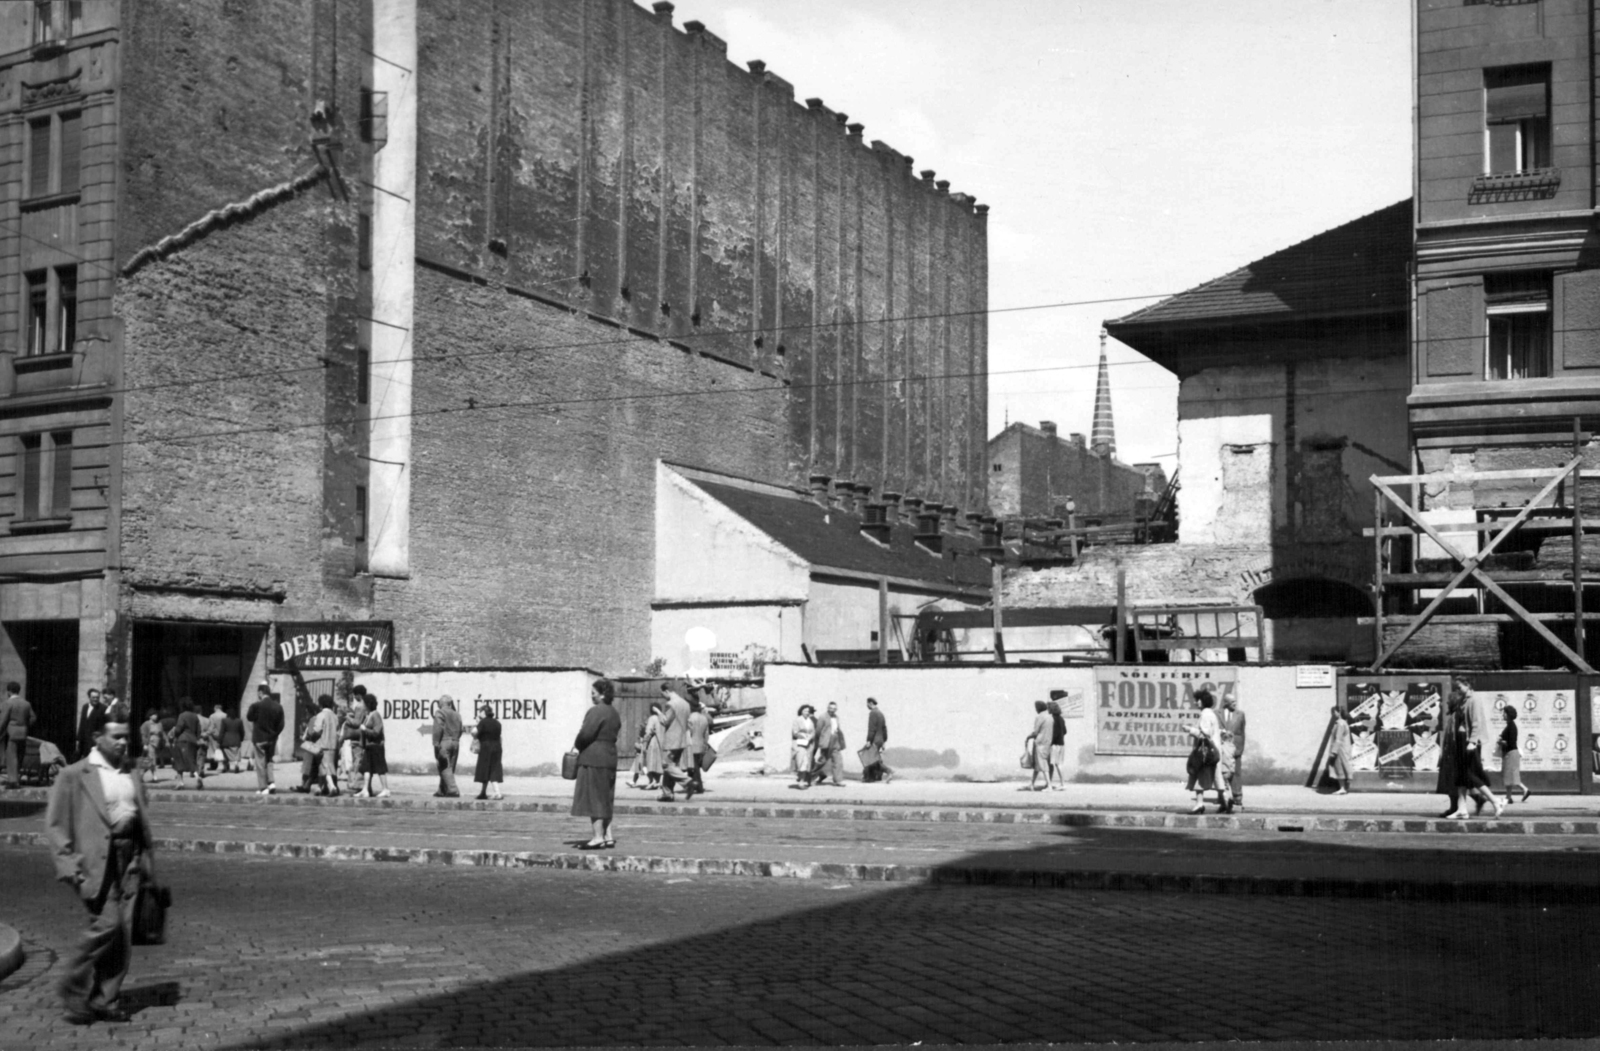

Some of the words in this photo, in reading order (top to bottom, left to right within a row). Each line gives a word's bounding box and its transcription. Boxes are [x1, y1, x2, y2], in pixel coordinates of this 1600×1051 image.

[280, 633, 387, 663] DEBRECEN
[305, 655, 360, 666] ÉTTEREM
[1099, 679, 1235, 709] FODRÁSZ
[383, 699, 460, 720] DEBRECN
[1103, 721, 1120, 731] AZ
